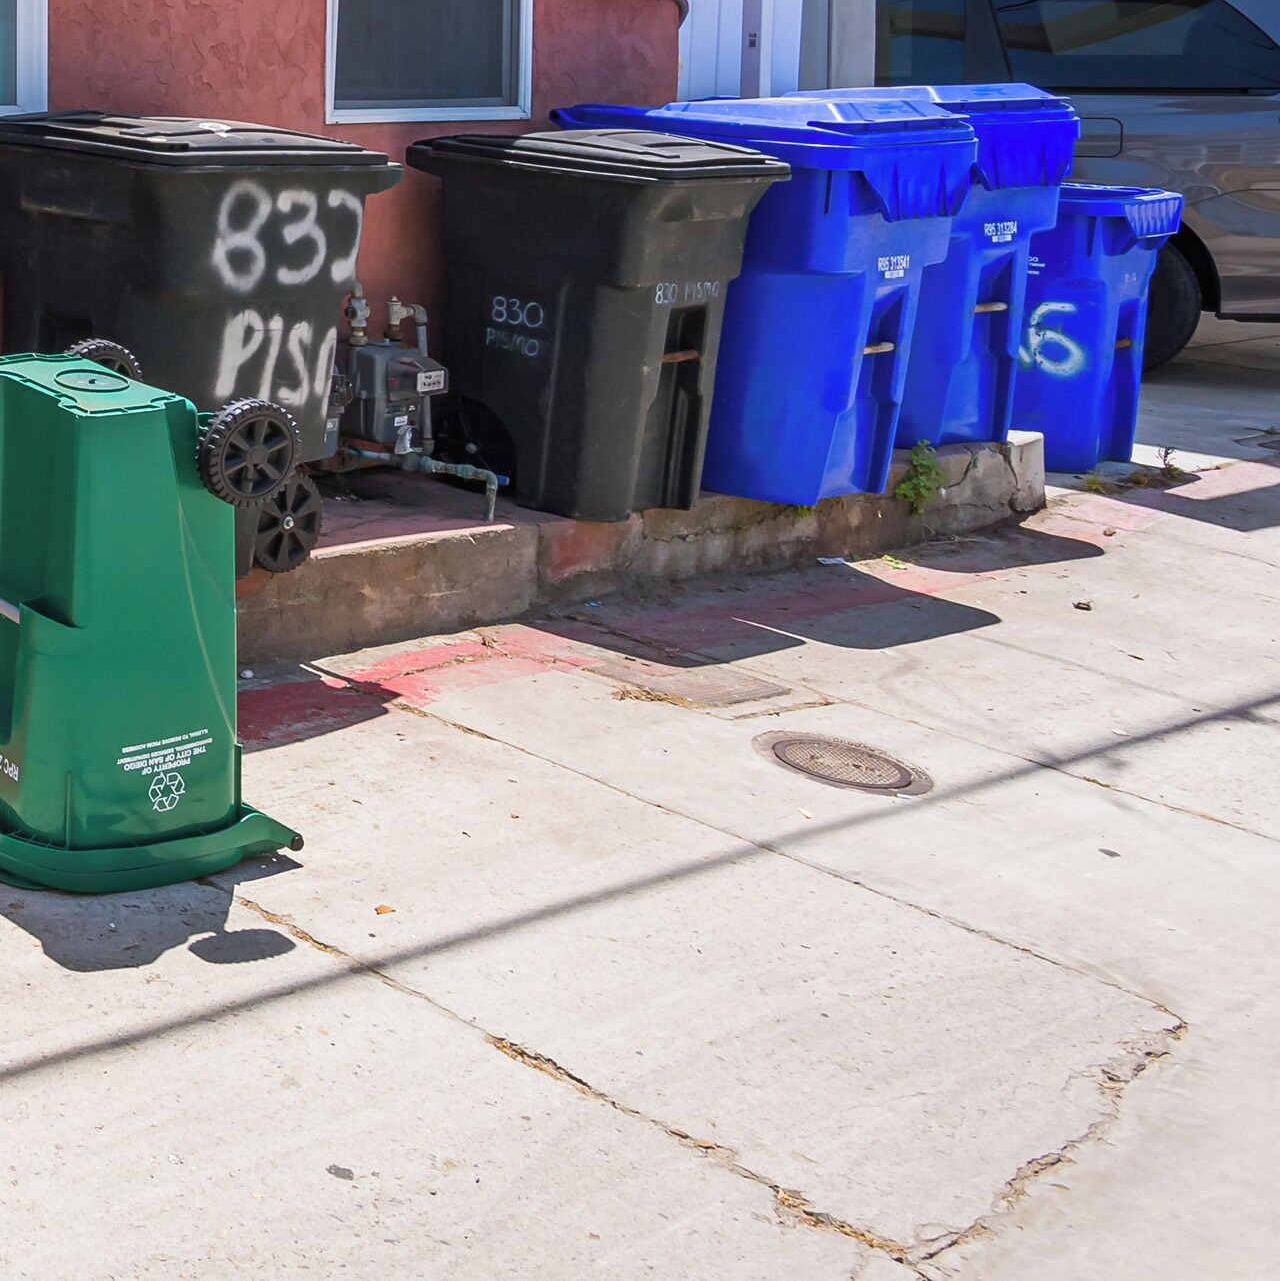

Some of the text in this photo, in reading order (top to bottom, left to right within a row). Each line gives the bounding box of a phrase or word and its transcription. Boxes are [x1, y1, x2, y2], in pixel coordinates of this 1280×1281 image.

[491, 294, 545, 329] 830
[485, 327, 541, 358] PISMO
[161, 735, 182, 746] REMOVE
[188, 728, 209, 738] ILLEGAL
[122, 743, 146, 753] ADDRESS
[146, 740, 161, 748] FROM
[116, 753, 150, 765] DEPARTMENT
[123, 745, 207, 772] THE CITY OF SAN DIEGO
[3, 758, 19, 782] RPC
[141, 757, 191, 776] PROPERTY OF
